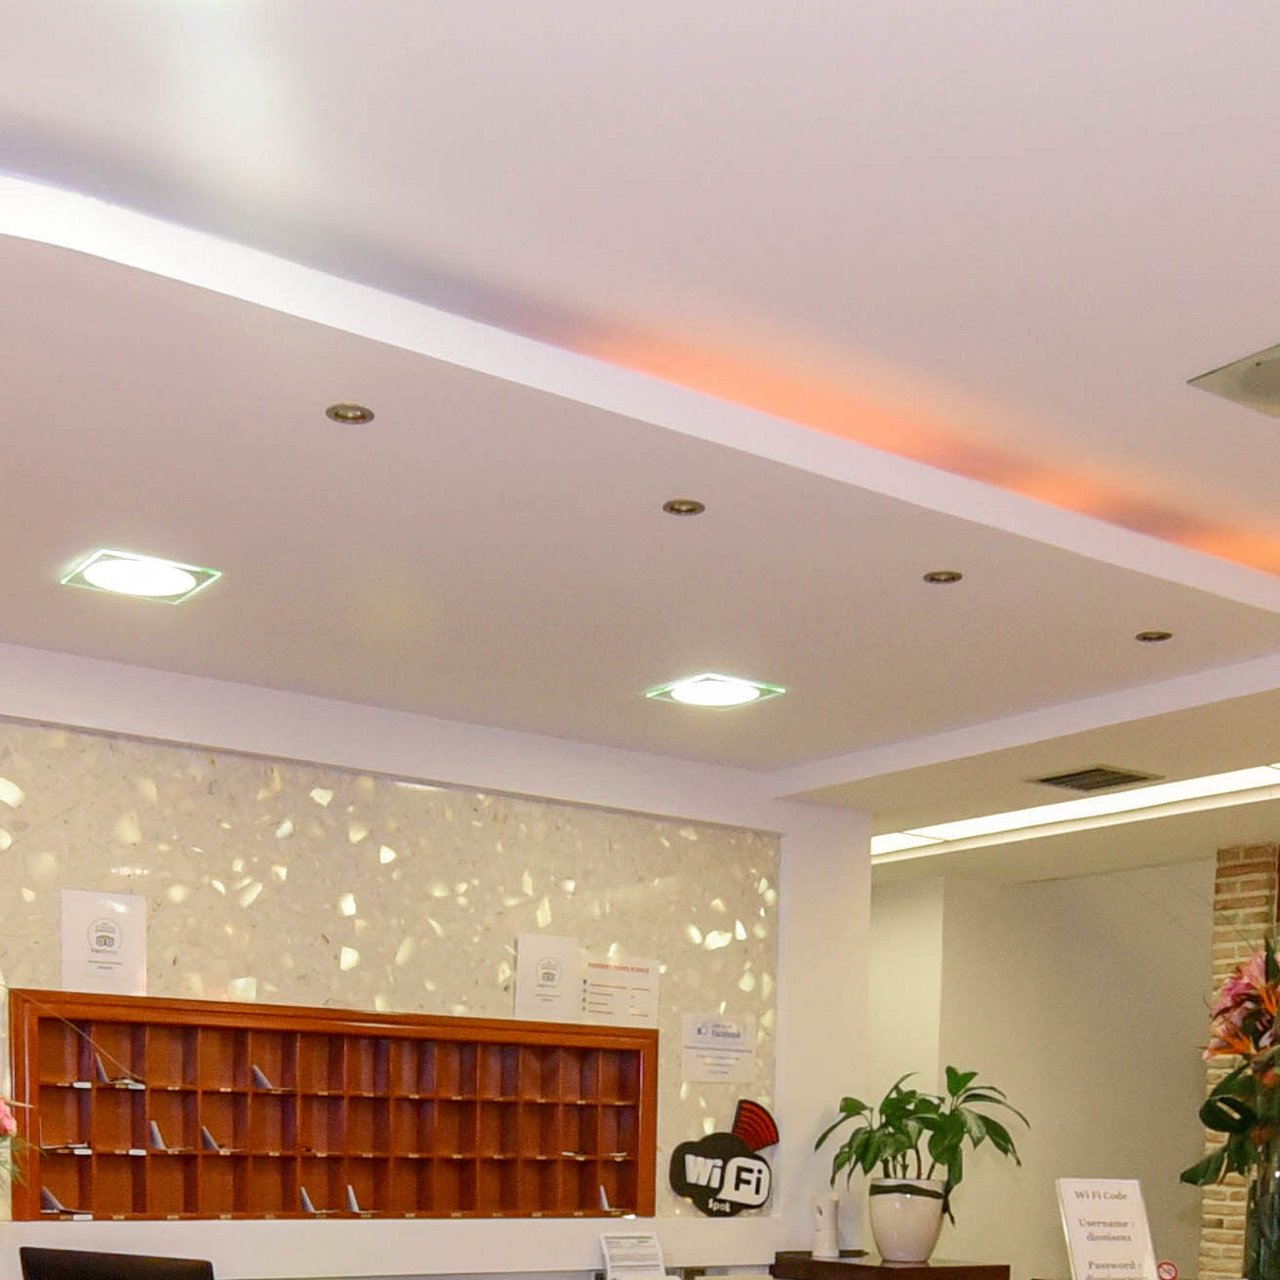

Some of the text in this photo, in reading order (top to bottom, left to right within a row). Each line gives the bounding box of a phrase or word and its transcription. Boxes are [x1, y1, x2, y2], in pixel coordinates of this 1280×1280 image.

[1104, 1190, 1128, 1200] Code
[708, 1198, 731, 1213] Spot
[1079, 1219, 1129, 1228] Username
[1088, 1260, 1136, 1270] Password
